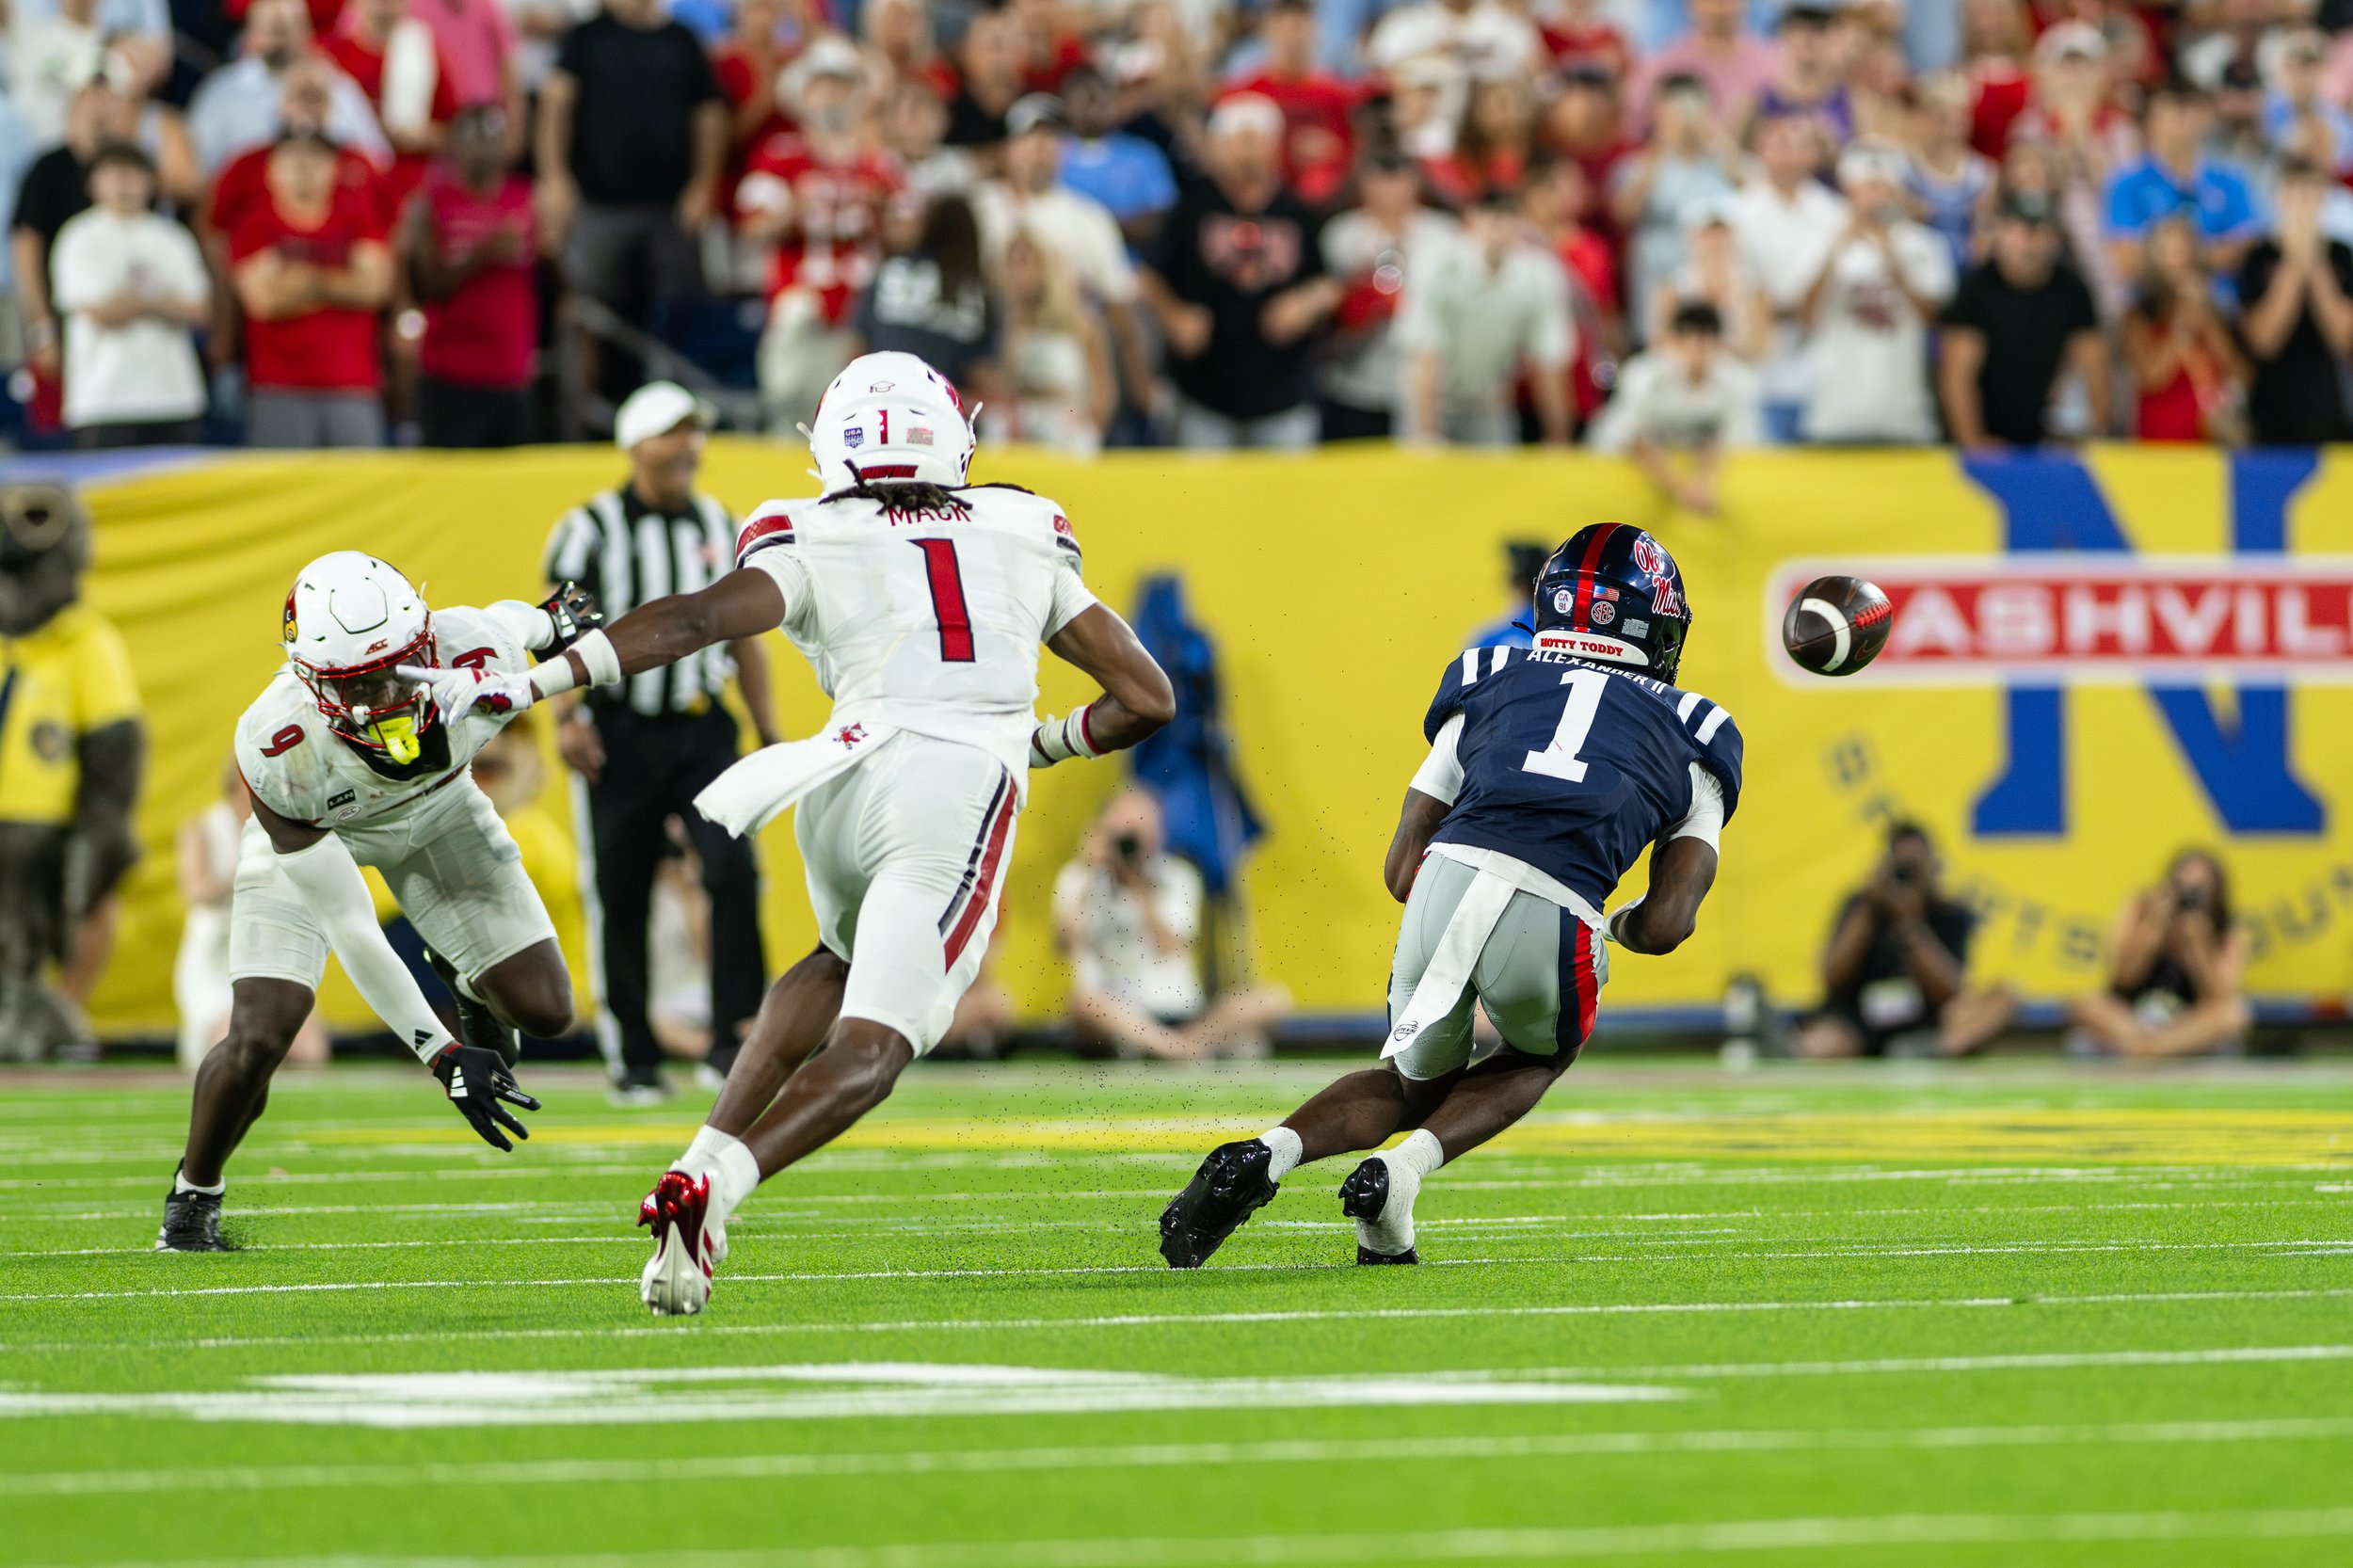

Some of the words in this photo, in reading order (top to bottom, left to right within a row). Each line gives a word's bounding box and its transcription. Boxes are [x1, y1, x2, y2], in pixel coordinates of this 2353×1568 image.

[877, 409, 888, 445] 1
[888, 502, 971, 527] MACK
[1634, 539, 1664, 575] Ole
[905, 537, 976, 664] 1
[1558, 593, 1569, 602] CA
[1558, 602, 1567, 611] 91
[1593, 603, 1613, 622] SEC
[1888, 580, 2353, 659] ASHVIL
[363, 638, 390, 656] ACC
[1540, 637, 1577, 649] HOTTY
[1580, 641, 1624, 657] TODDY
[1526, 648, 1649, 686] ALEXANDER
[1651, 680, 1669, 695] II
[259, 724, 306, 758] 9
[1521, 668, 1610, 783] 1
